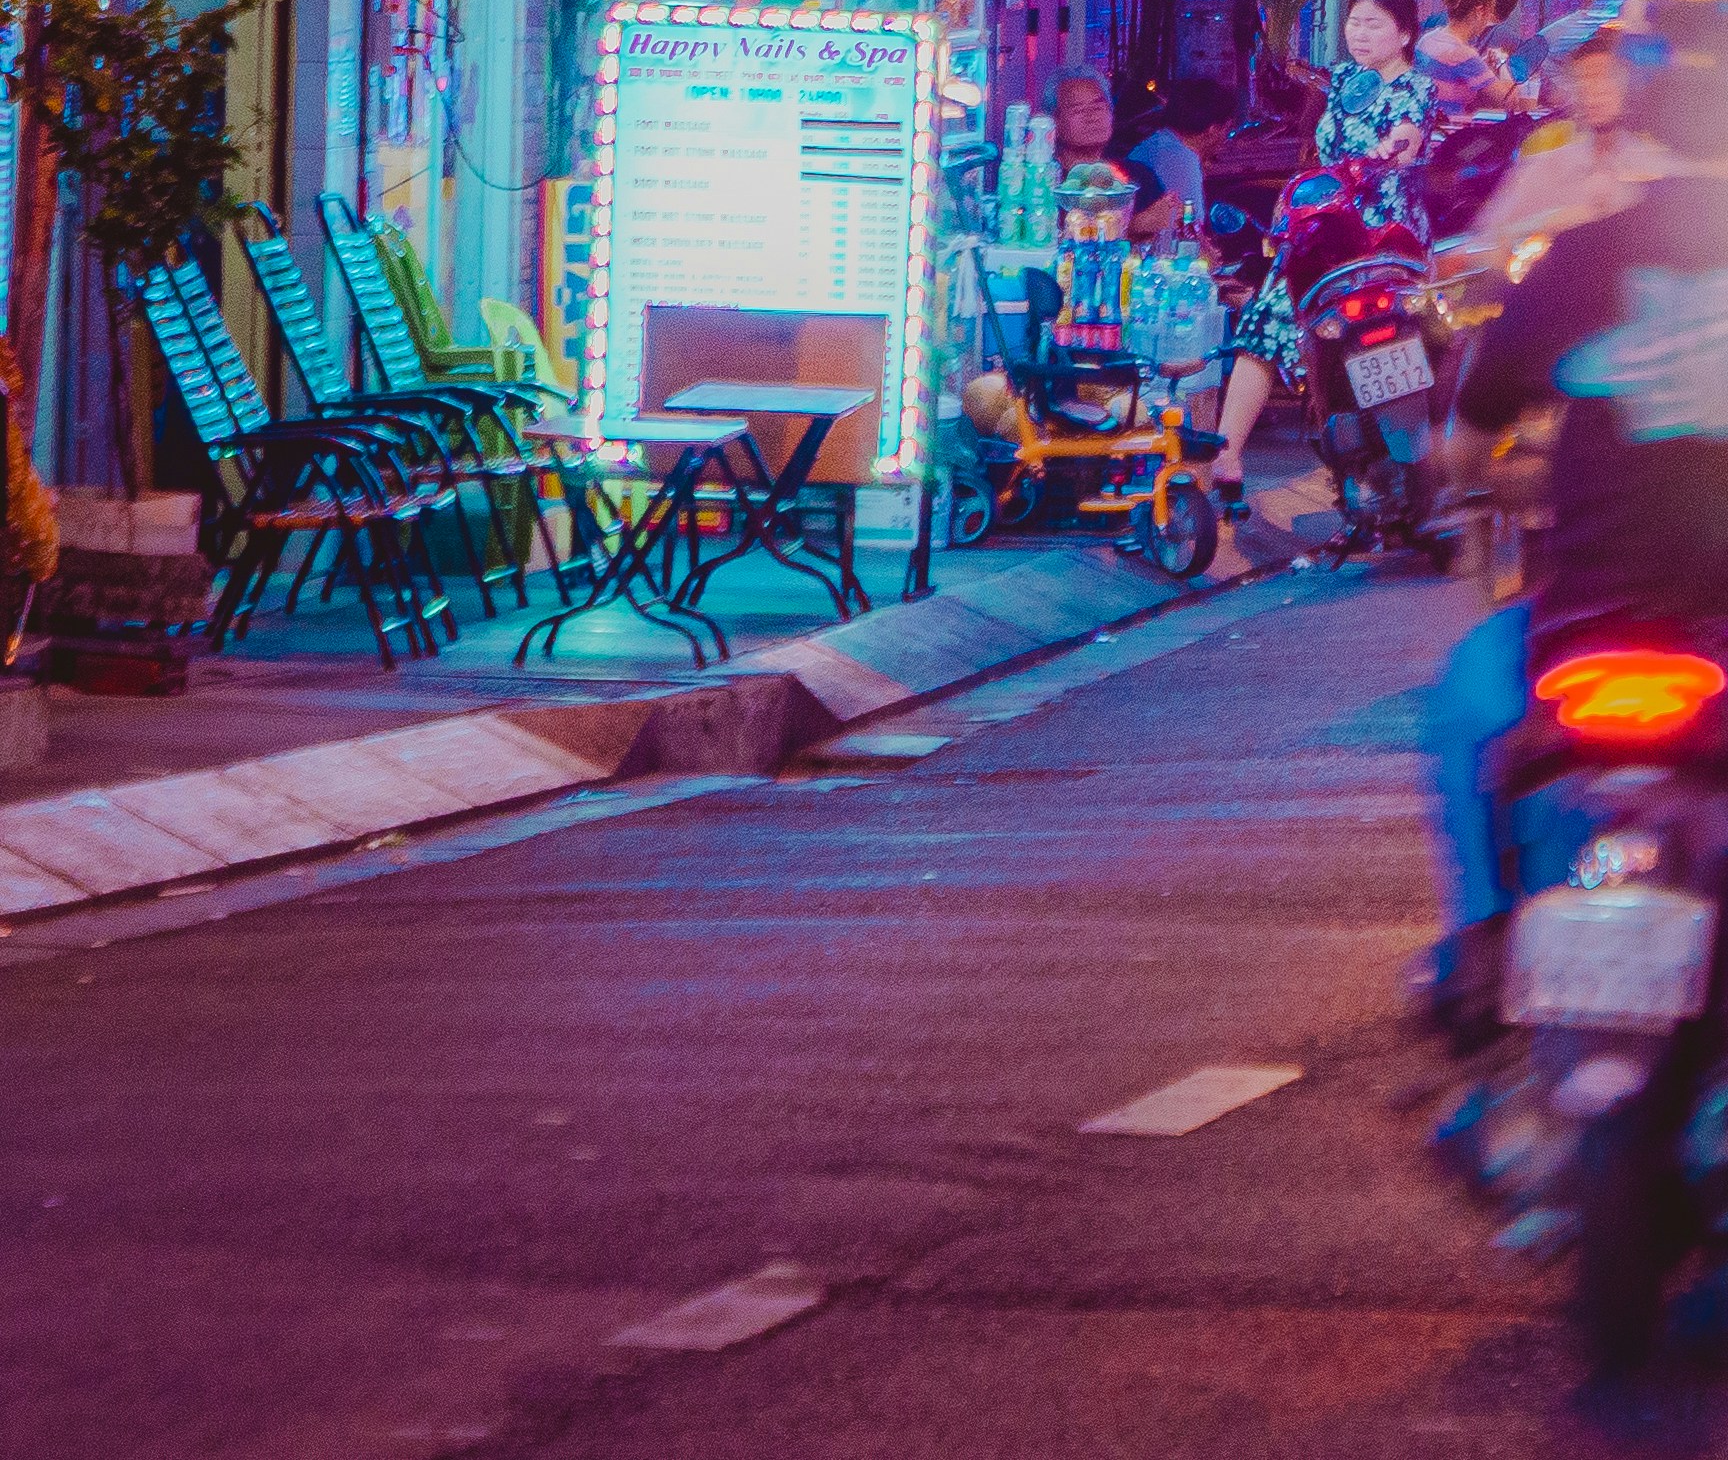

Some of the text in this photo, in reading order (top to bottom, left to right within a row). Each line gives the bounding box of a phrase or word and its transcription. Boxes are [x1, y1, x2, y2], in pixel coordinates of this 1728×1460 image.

[629, 33, 908, 69] Happy Nails & Spa
